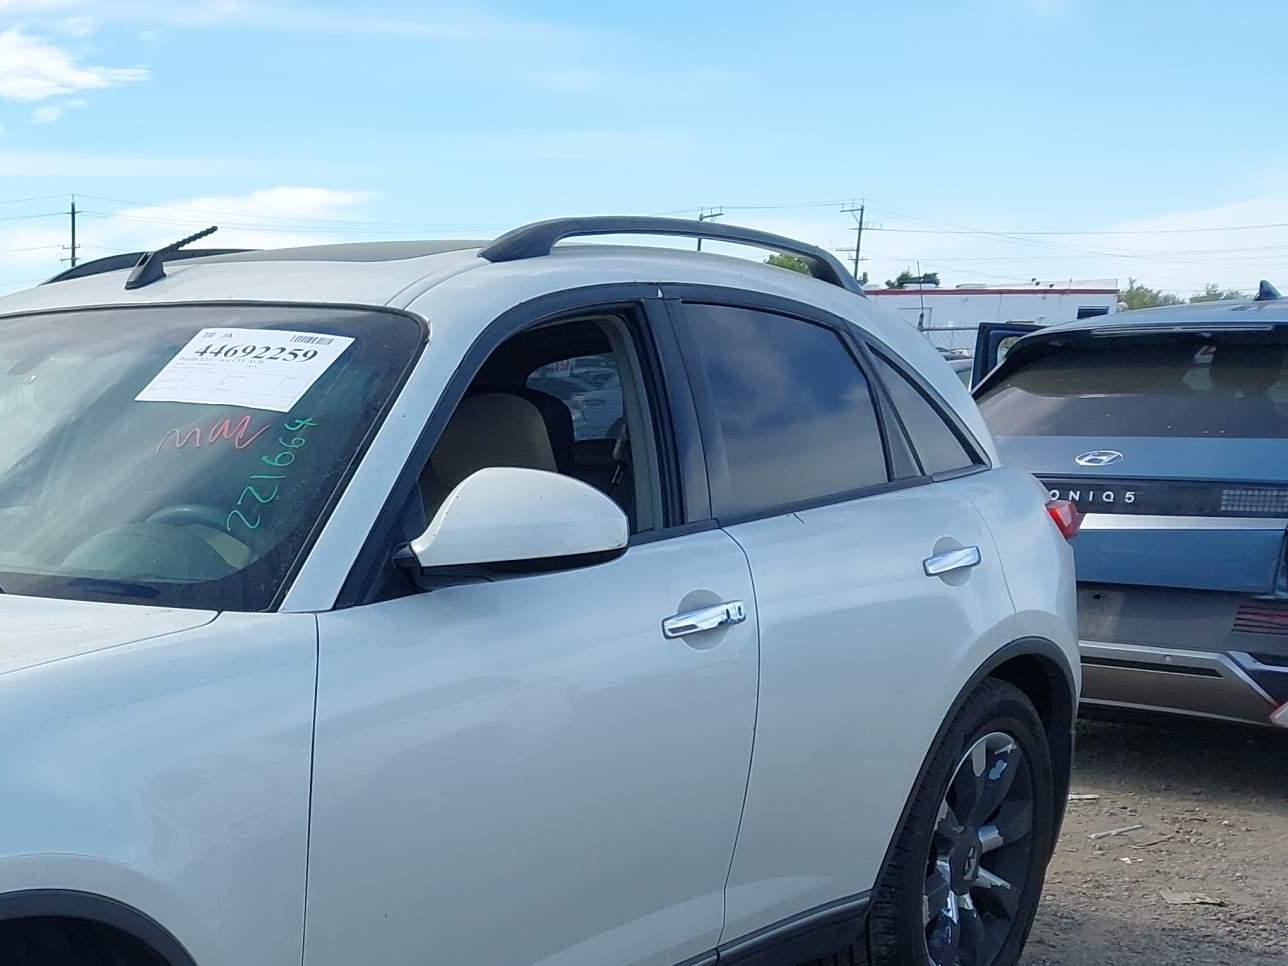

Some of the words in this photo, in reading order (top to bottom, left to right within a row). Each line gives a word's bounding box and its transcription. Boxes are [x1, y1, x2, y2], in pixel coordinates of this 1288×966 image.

[194, 343, 319, 363] 44692259
[226, 416, 318, 532] 221664
[1124, 491, 1136, 503] 5
